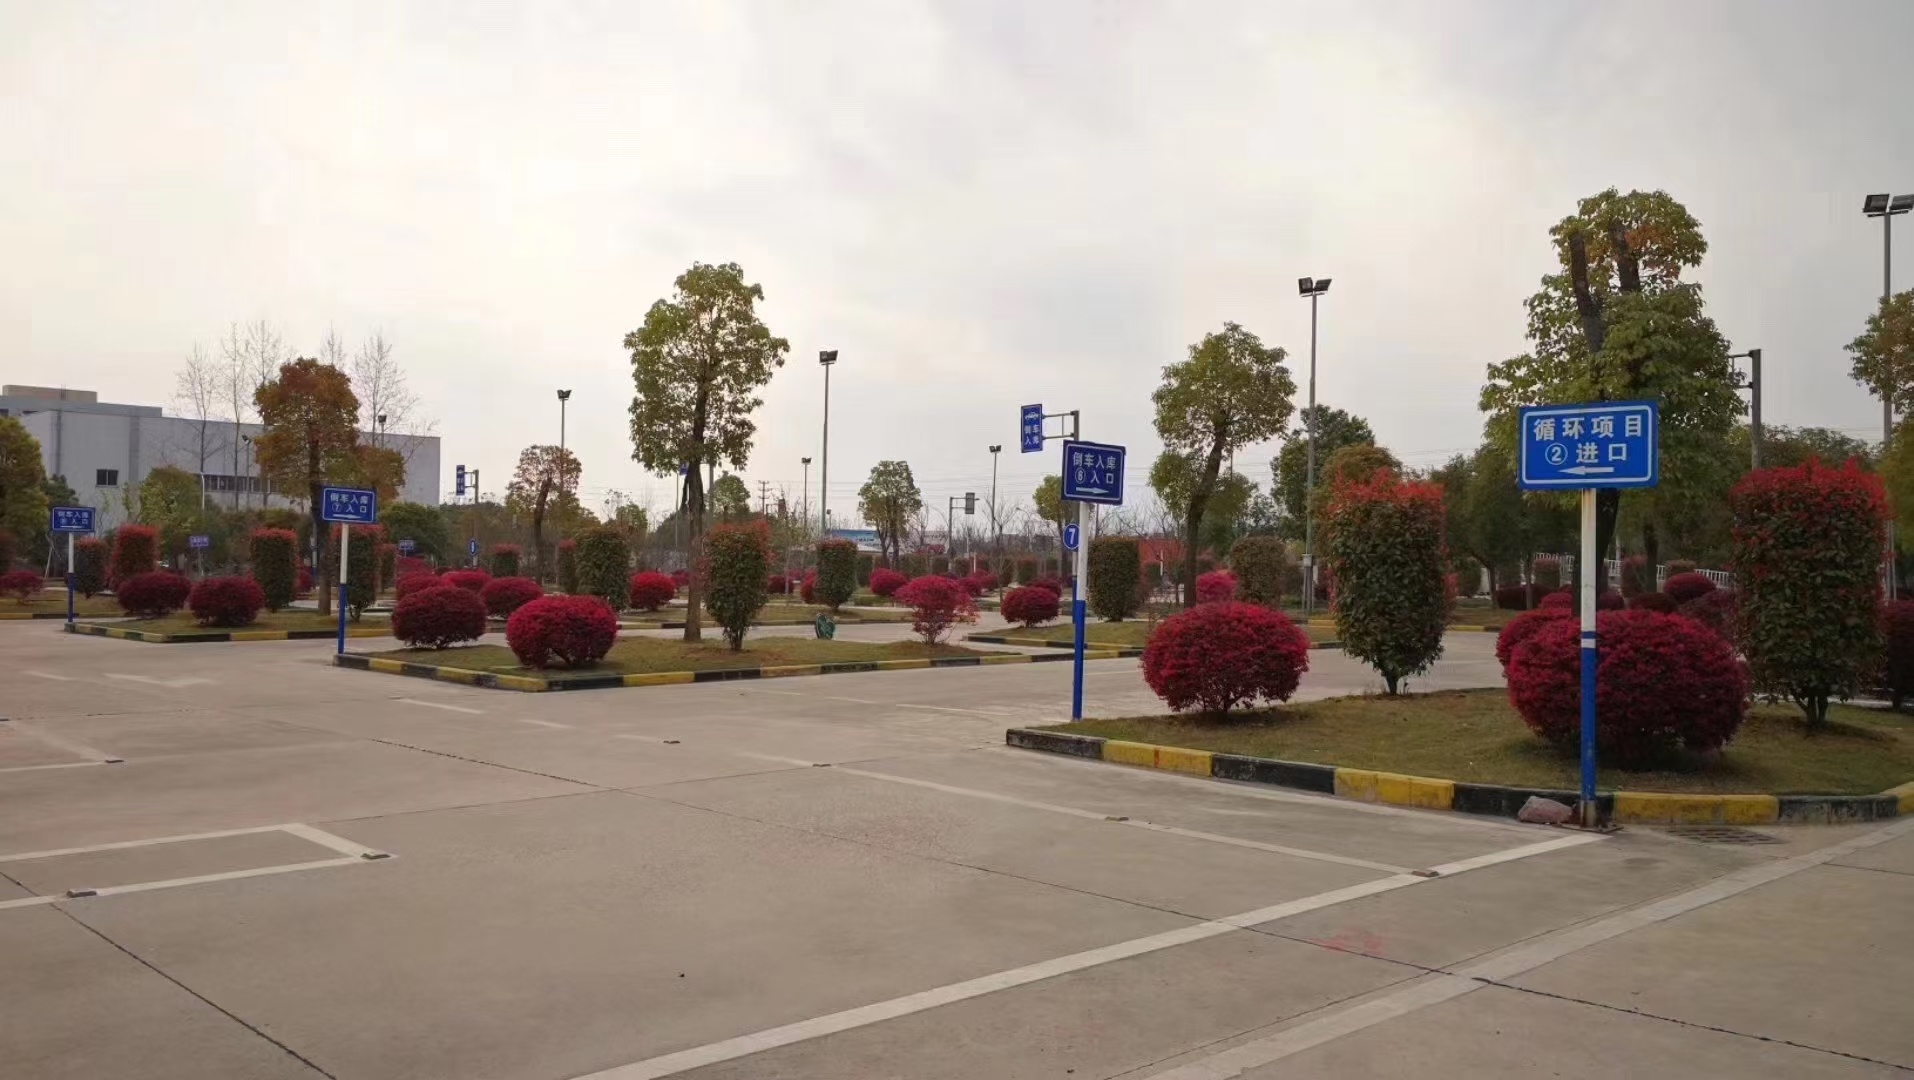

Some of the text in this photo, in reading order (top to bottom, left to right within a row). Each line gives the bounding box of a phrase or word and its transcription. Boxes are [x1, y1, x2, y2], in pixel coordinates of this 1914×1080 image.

[1534, 415, 1641, 441] 循环项目
[1072, 451, 1116, 470] 倒车入库
[1068, 528, 1076, 545] 7
